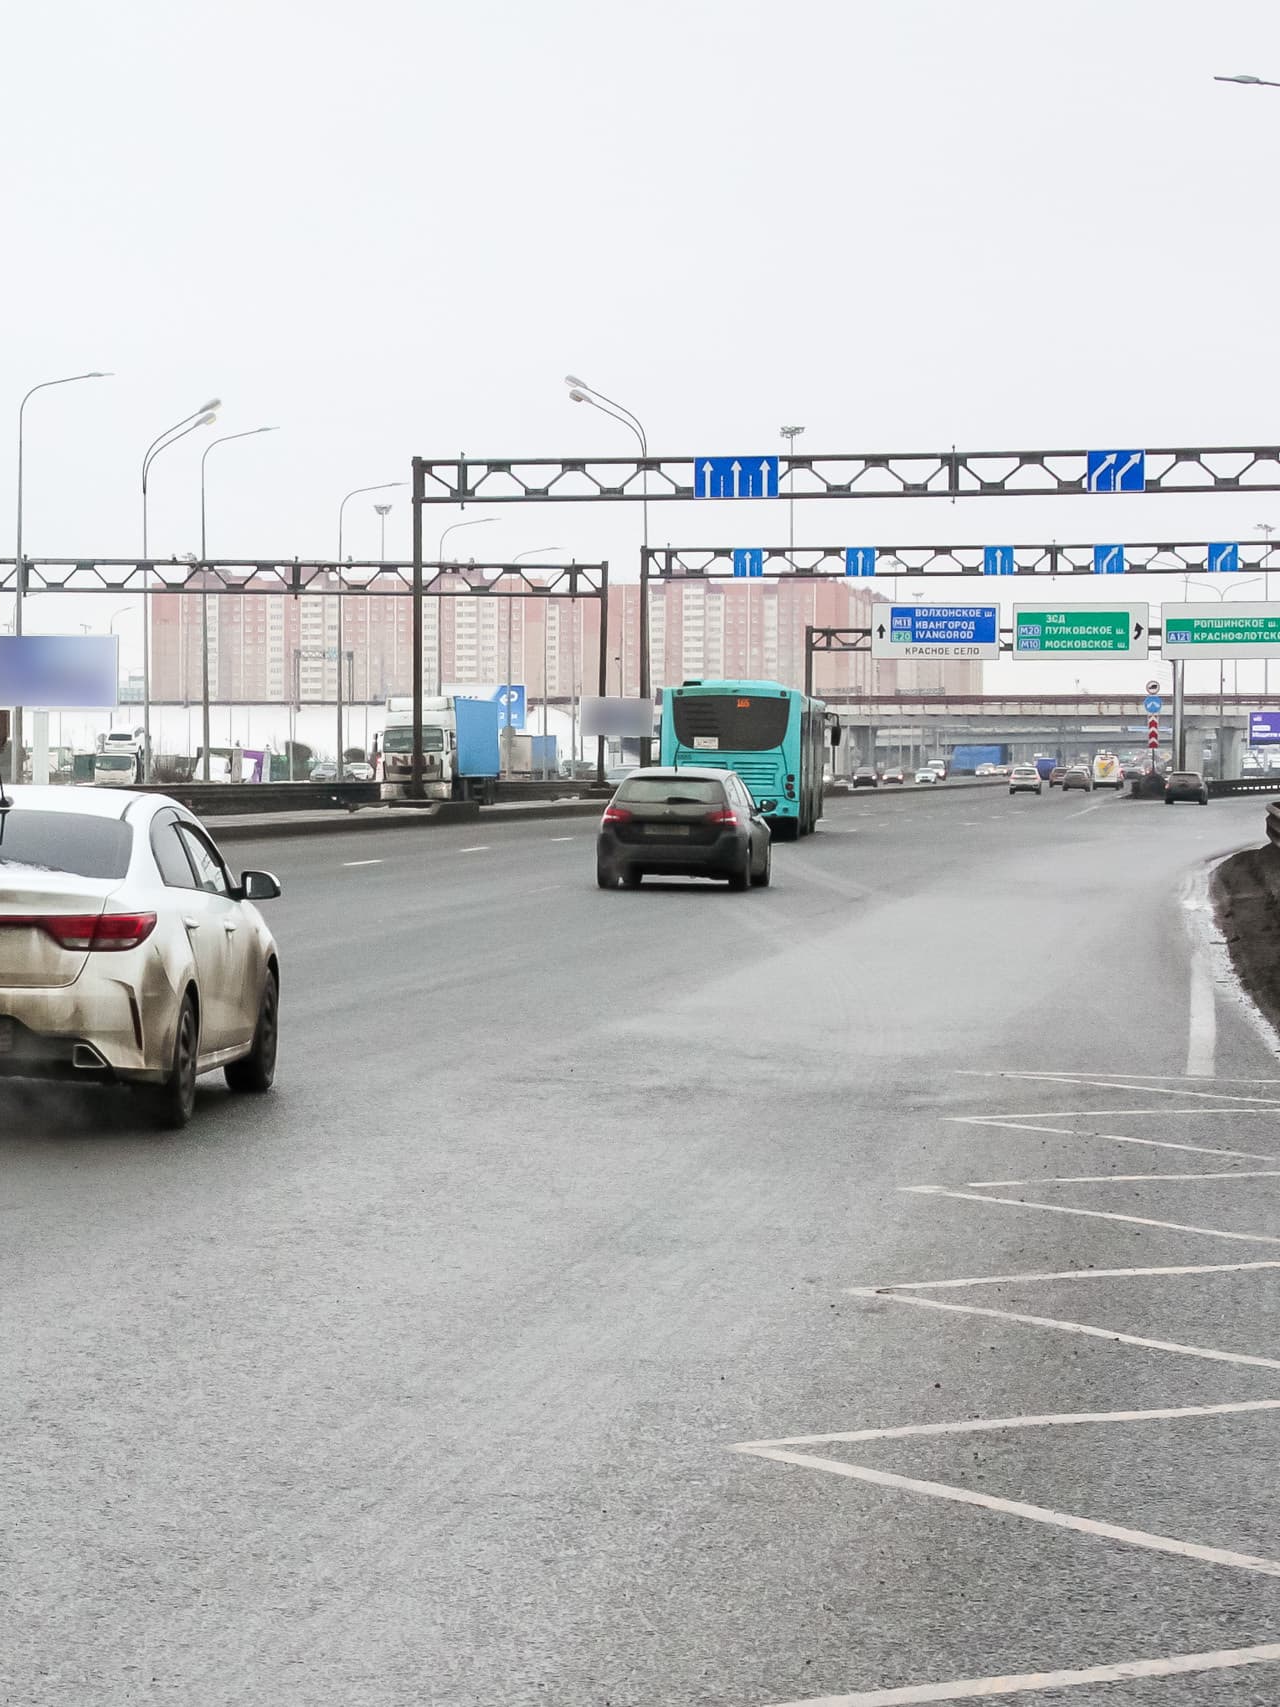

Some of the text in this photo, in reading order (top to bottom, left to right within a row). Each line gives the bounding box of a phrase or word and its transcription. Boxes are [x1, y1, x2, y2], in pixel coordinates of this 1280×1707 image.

[914, 608, 982, 617] ВОЛХОНСКОЕ
[1045, 614, 1066, 624] ЗСД
[915, 621, 975, 630] ИВАНГОРОД
[1193, 619, 1265, 629] РОПШИНСКОЕ
[915, 631, 974, 639] IVANGOROD
[1045, 626, 1113, 635] ПУЛКОВСКОЕ
[1044, 640, 1114, 649] МОСКОВСКОЕ
[905, 647, 981, 656] КРАСНОЕ СЕЛО
